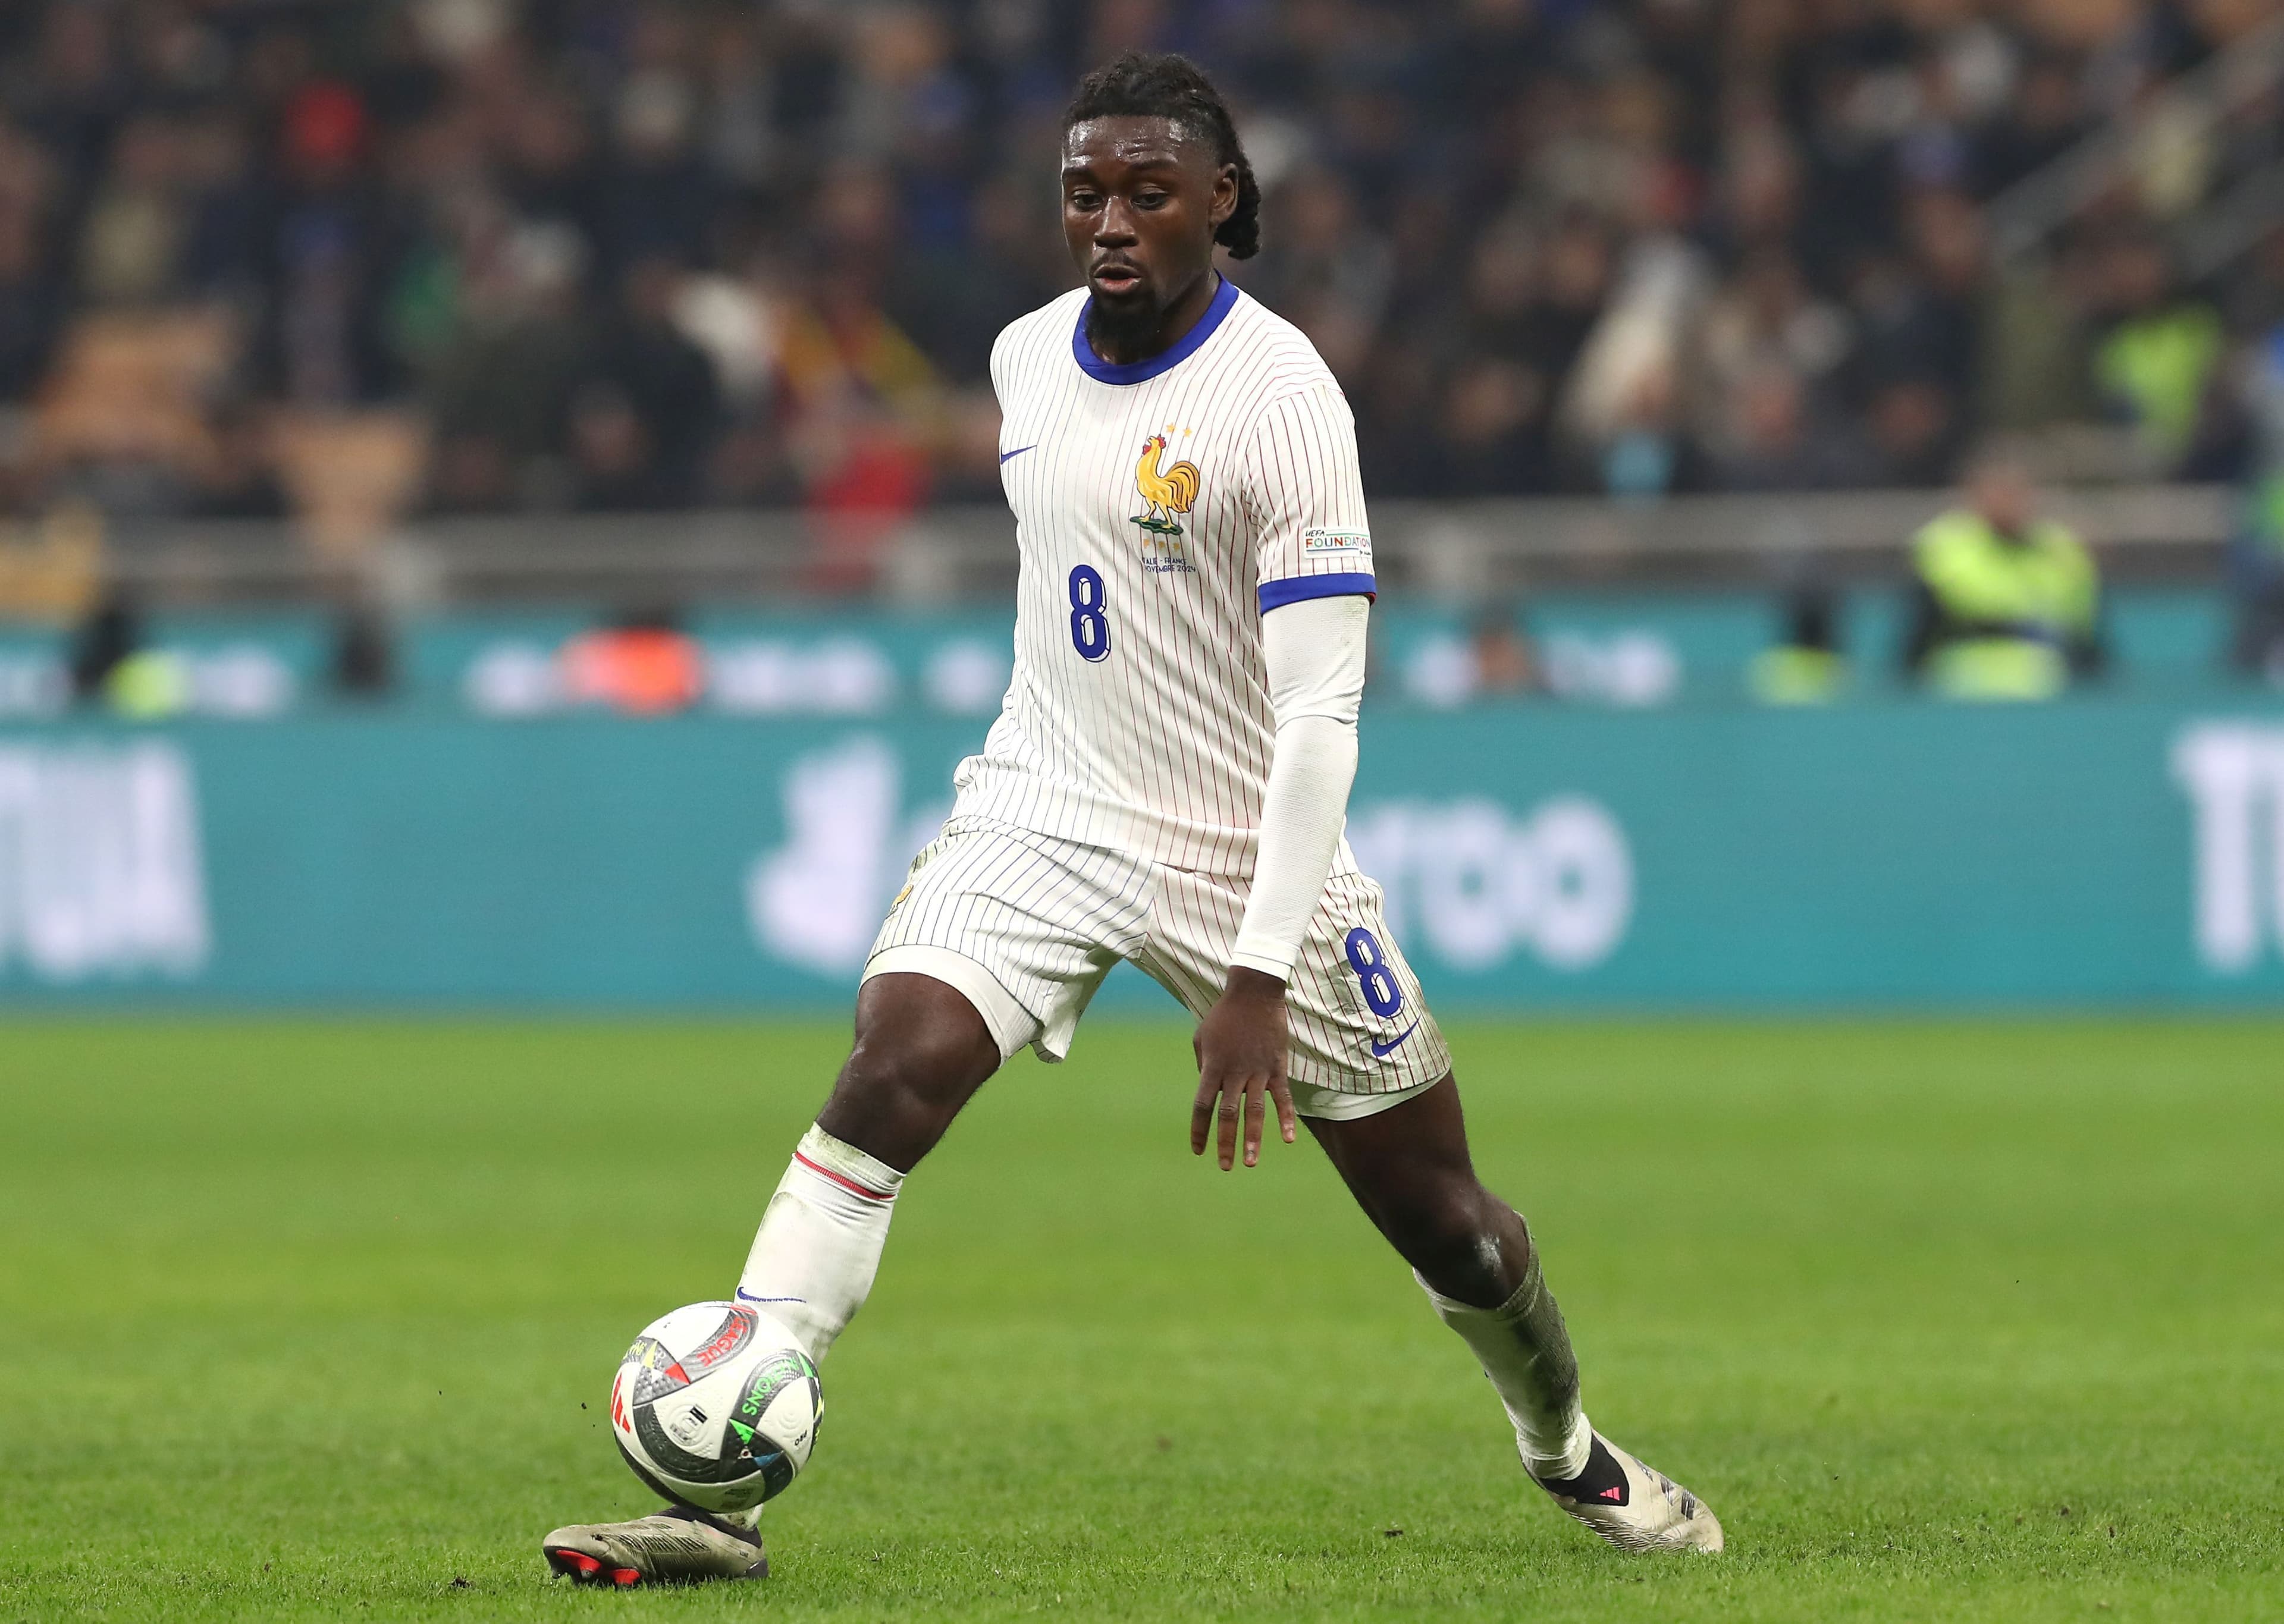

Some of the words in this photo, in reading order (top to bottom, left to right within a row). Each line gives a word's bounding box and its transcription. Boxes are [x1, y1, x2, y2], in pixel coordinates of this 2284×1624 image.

[1165, 557, 1187, 566] FRANCE
[1306, 536, 1370, 548] FOUNDATION
[1069, 564, 1111, 662] 8
[1345, 926, 1405, 1019] 8
[697, 1315, 751, 1367] LEAGUE
[742, 1356, 799, 1416] NATIONS
